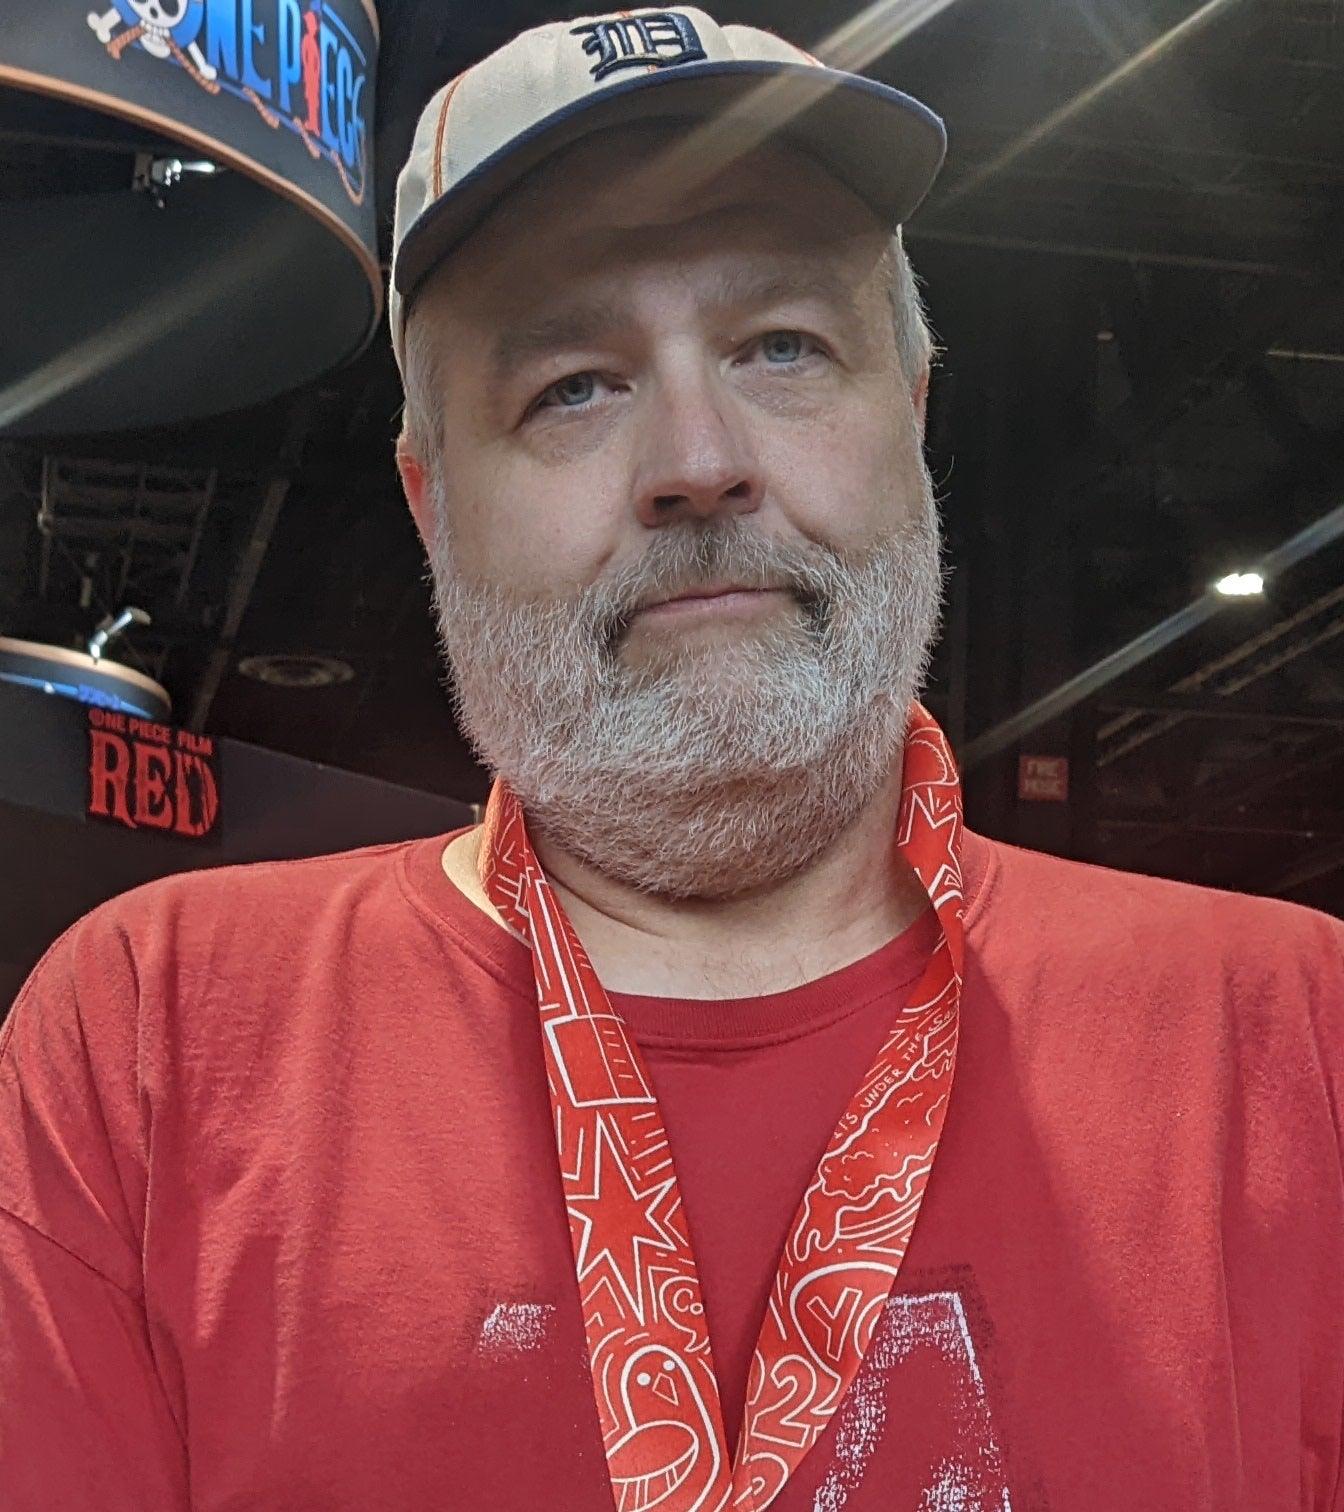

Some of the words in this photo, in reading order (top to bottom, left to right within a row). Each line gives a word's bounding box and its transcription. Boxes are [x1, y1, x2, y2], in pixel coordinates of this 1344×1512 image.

[89, 709, 126, 732] ONE
[129, 718, 172, 744] PIECE
[178, 730, 213, 755] FILM
[89, 729, 219, 837] RED
[860, 1068, 903, 1108] UNDER
[902, 1033, 924, 1061] THE
